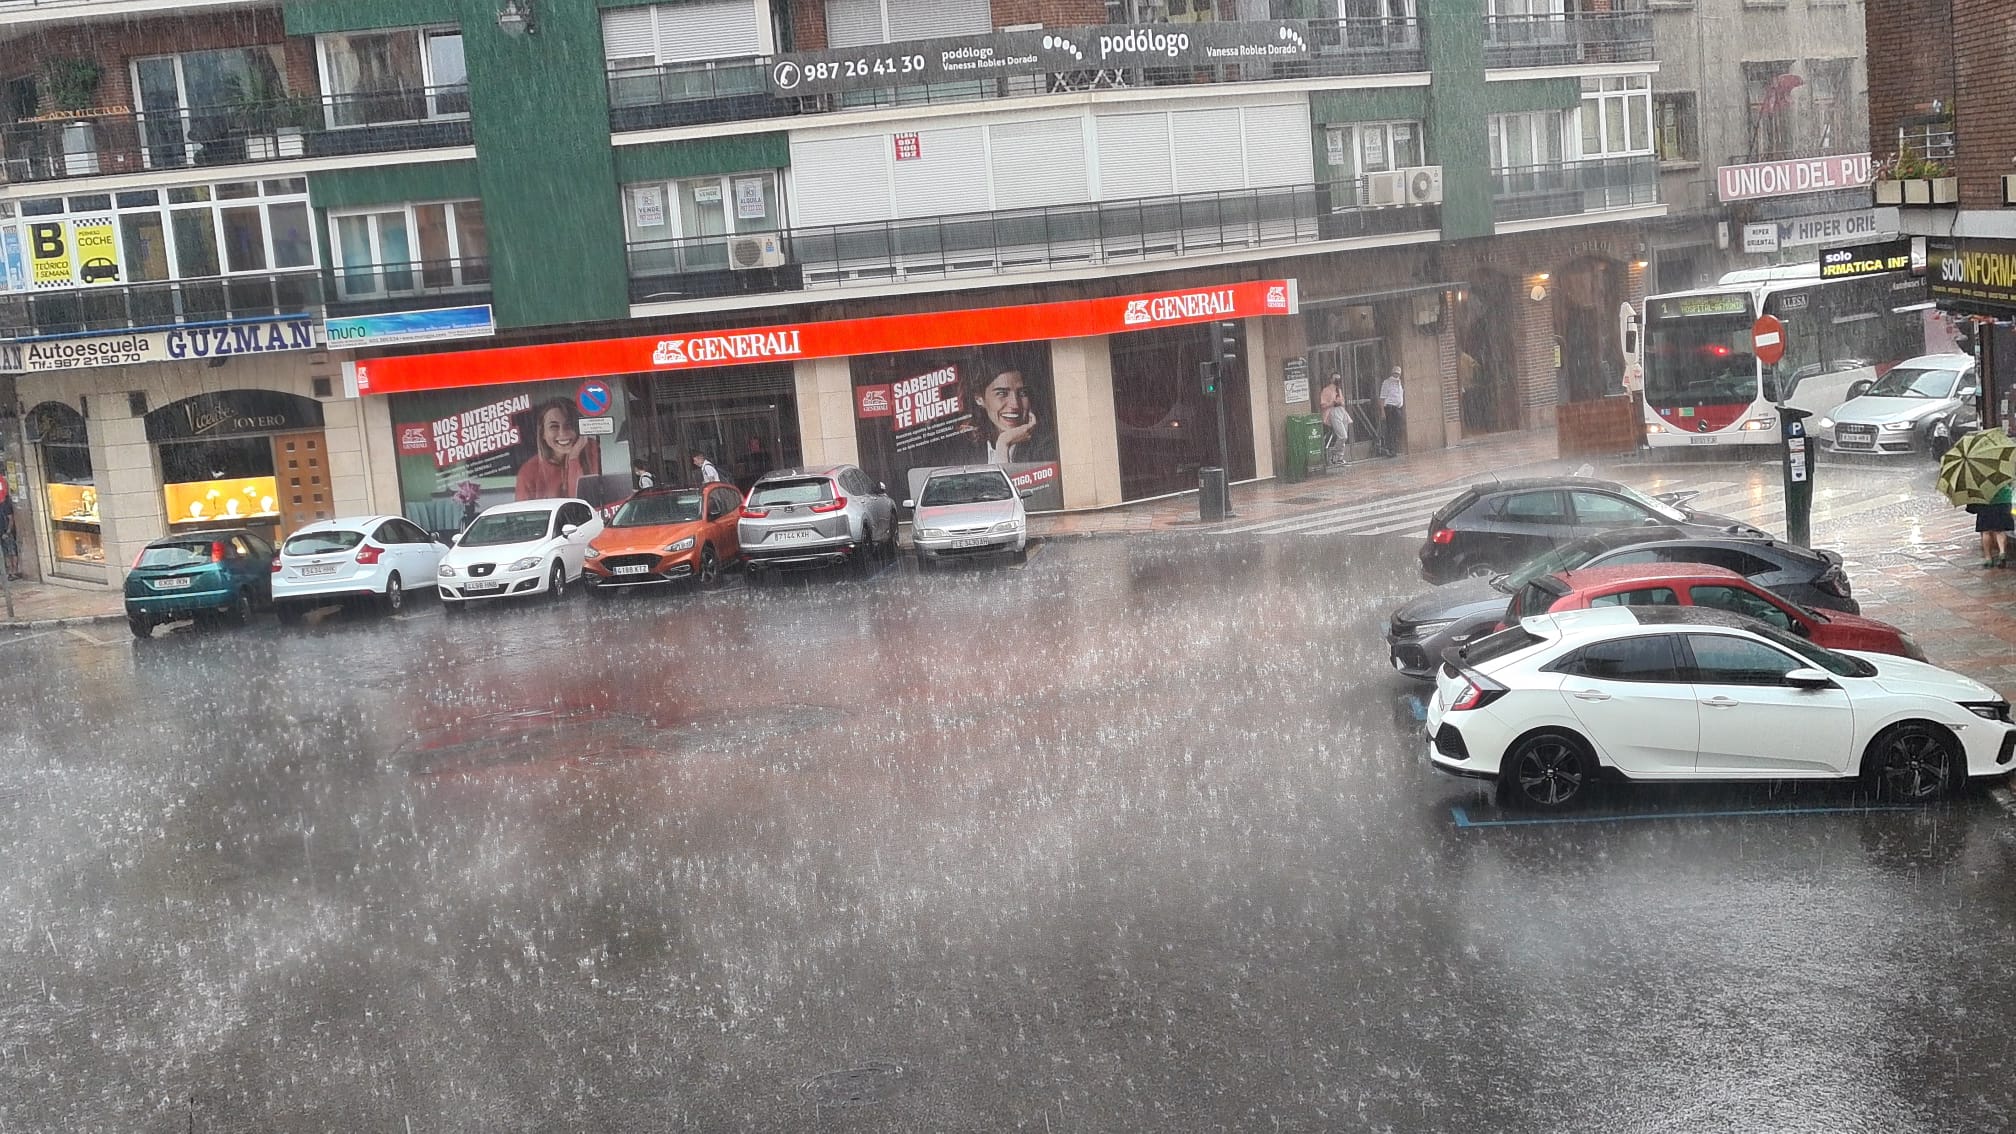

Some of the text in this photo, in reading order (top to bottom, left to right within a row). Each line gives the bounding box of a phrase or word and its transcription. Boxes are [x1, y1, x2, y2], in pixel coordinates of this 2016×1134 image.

[1100, 29, 1189, 59] podólogo
[1206, 43, 1297, 57] Vanessa Robles Dorado
[942, 47, 993, 63] podólogo
[942, 54, 1038, 71] Vanessa Robles Dorado
[804, 55, 925, 81] 987 26 41 30
[1726, 164, 1791, 197] UNION
[1796, 161, 1835, 189] DEL
[1800, 220, 1840, 240] HIPER
[31, 223, 64, 259] B
[78, 235, 112, 247] COCHE
[35, 260, 69, 271] TEÓRICO
[1825, 251, 1852, 263] solo
[1888, 256, 1910, 269] INF
[40, 268, 70, 278] SEMANA
[1151, 289, 1235, 321] GENERALI
[167, 320, 312, 358] GUZMAN
[327, 325, 366, 341] muro
[28, 336, 149, 361] Autoescuela
[687, 330, 801, 362] GENERALI
[0, 345, 22, 370] AN
[54, 358, 80, 368] 987
[122, 353, 141, 362] 70
[893, 367, 956, 399] SABEMOS
[895, 387, 940, 414] LO QUE
[232, 414, 286, 431] JOYERO
[432, 394, 530, 437] NOS INTERESAN
[896, 411, 913, 428] TE
[915, 397, 960, 425] MUEVE
[1792, 422, 1801, 435] P
[434, 431, 459, 451] TUS
[436, 452, 446, 466] Y
[448, 428, 519, 463] PROYECTOS
[1032, 467, 1053, 481] TODO
